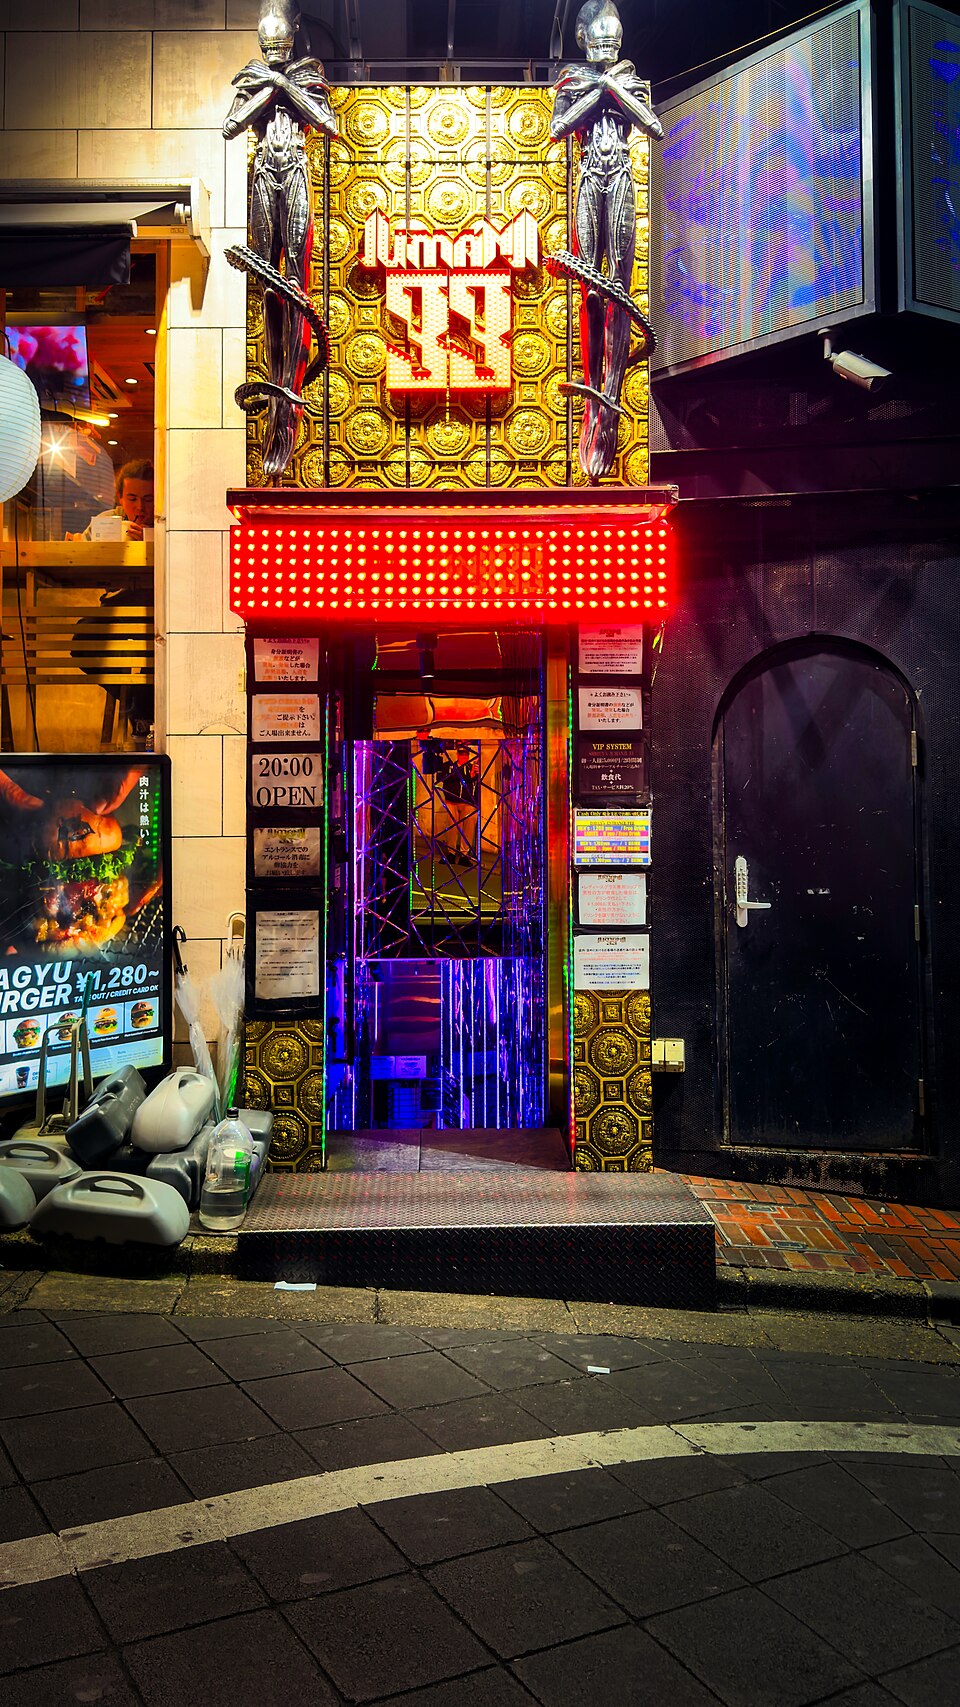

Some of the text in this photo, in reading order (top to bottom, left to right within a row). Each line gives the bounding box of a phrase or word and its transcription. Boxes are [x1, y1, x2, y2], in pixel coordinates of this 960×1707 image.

[258, 757, 313, 777] 20:00
[256, 786, 316, 807] OPEN
[139, 775, 150, 846] 肉汁は熱い。
[0, 983, 73, 1014] RGER
[91, 992, 106, 1000] OUT
[110, 988, 133, 998] CREDIT
[132, 985, 150, 994] CARD
